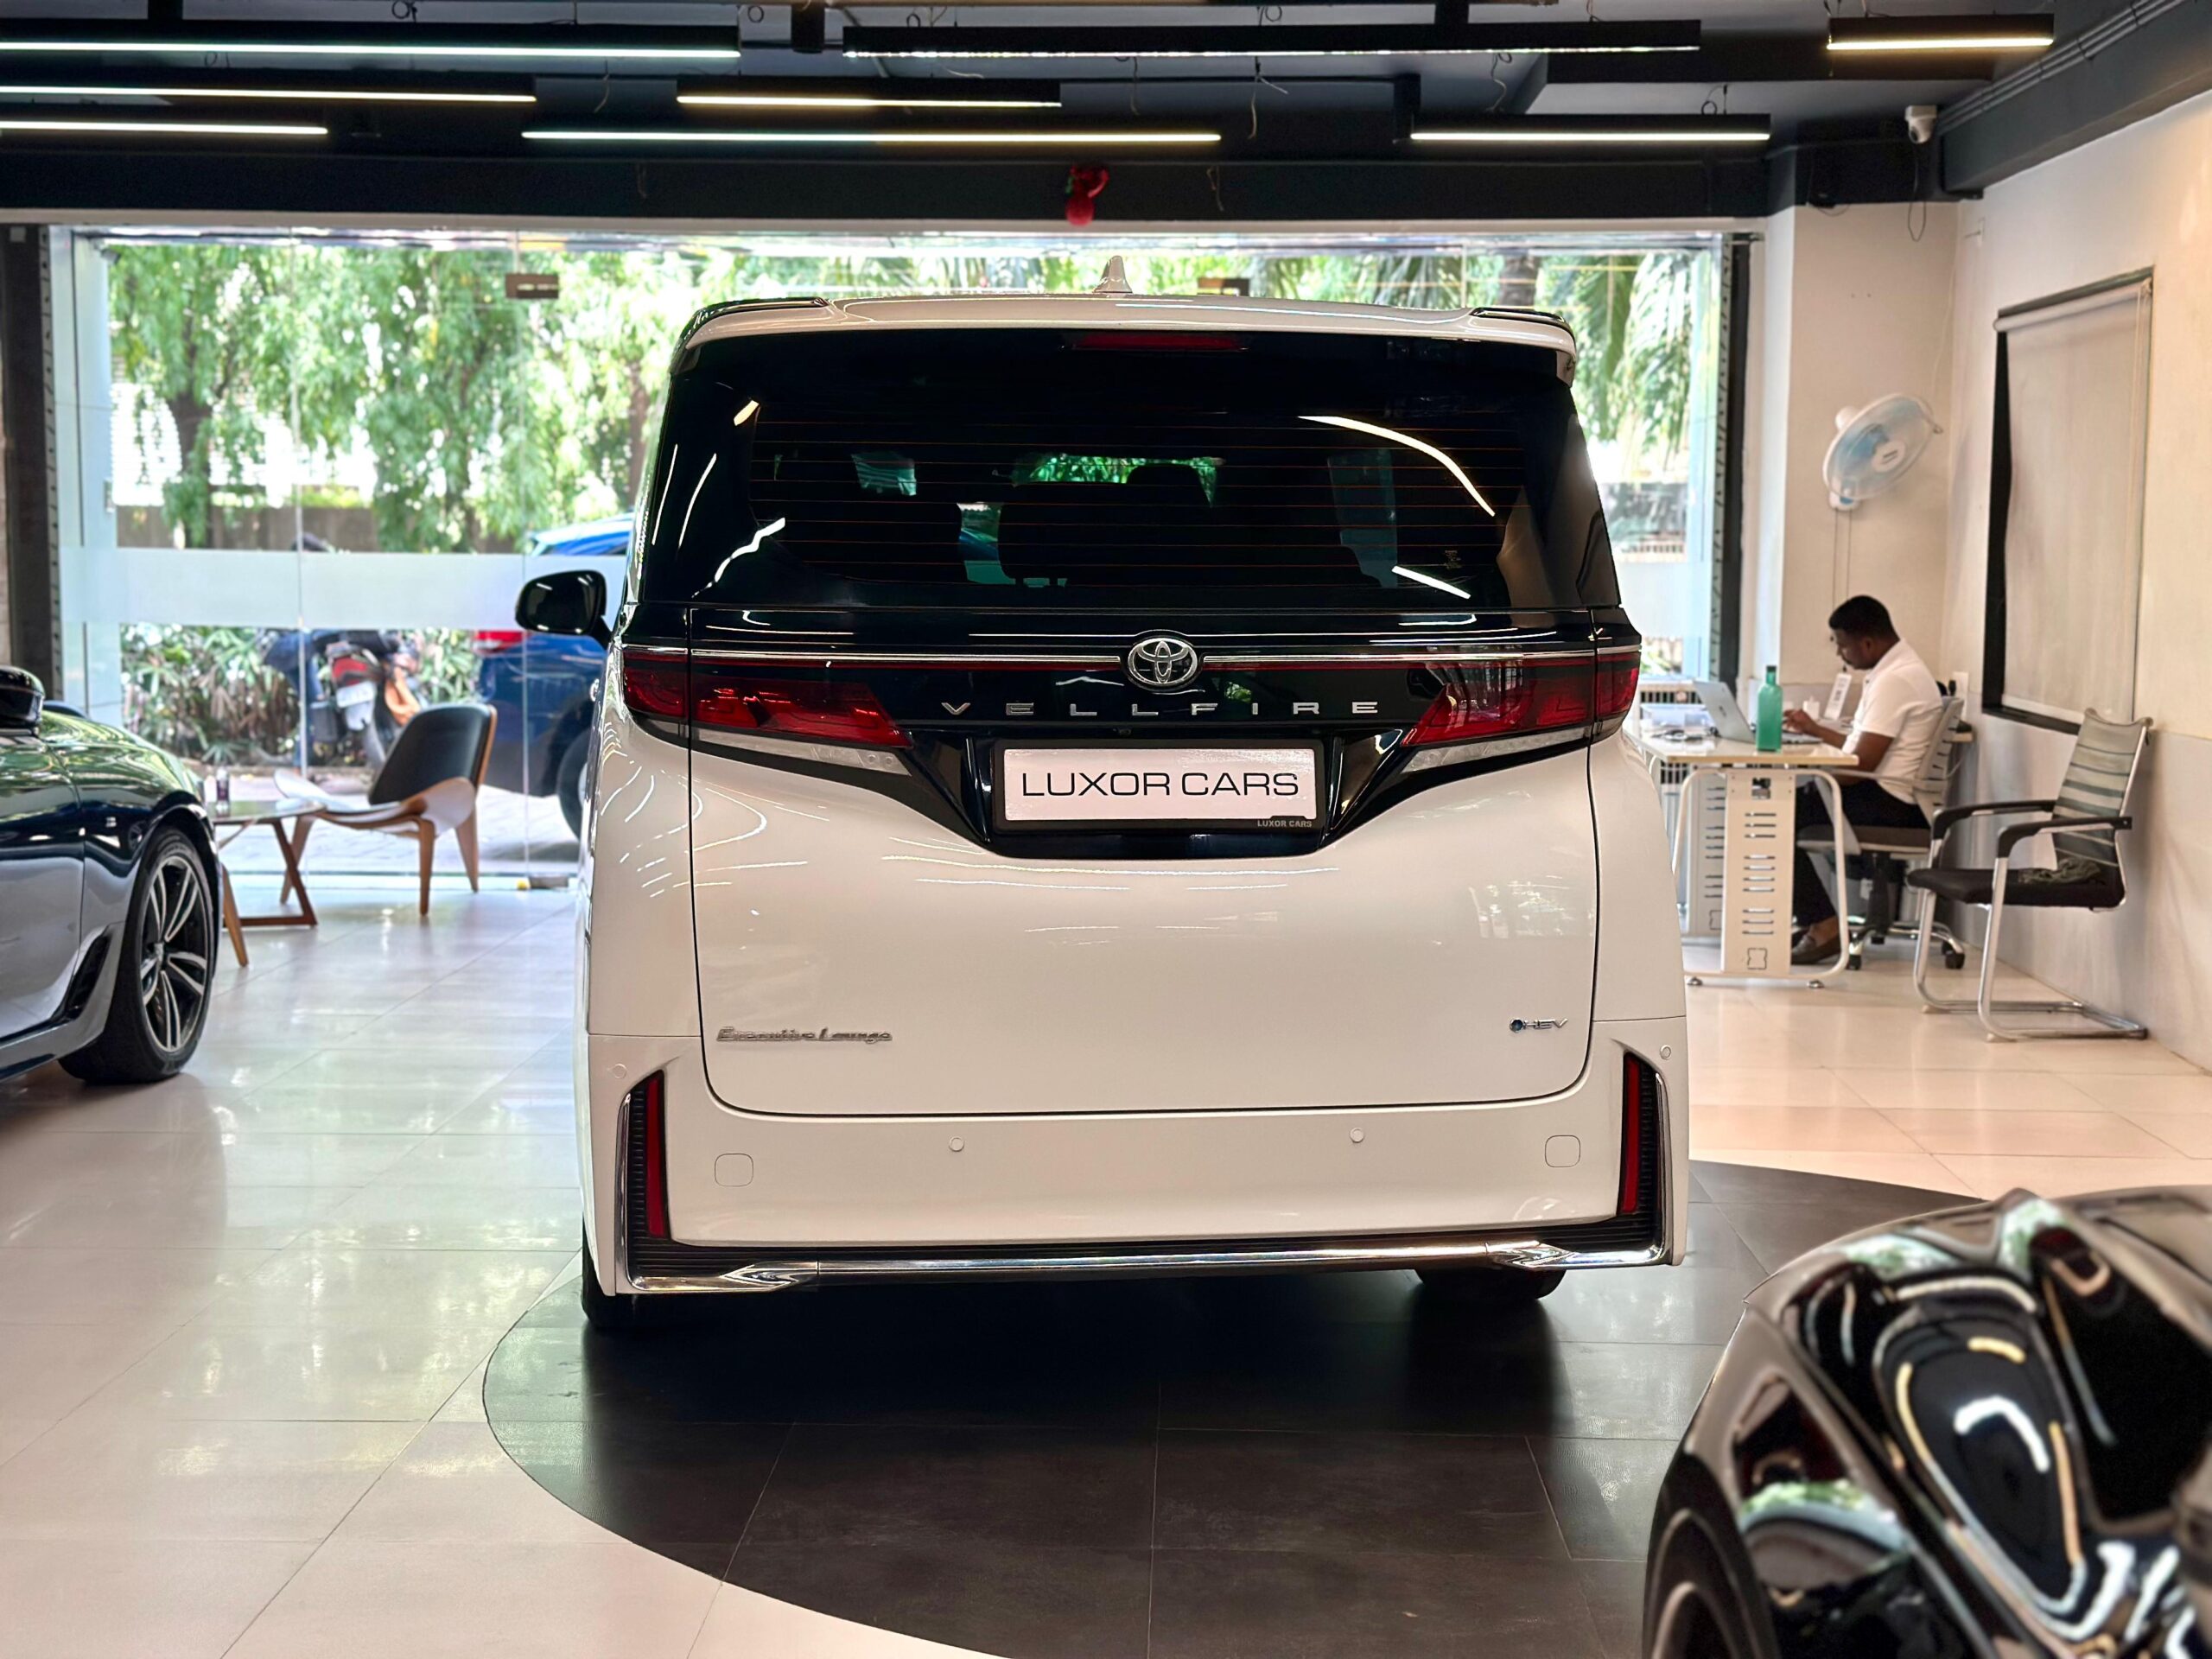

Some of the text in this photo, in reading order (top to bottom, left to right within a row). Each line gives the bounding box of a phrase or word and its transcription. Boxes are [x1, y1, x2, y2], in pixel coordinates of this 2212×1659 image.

[941, 701, 1379, 716] VELLFIRE
[1022, 772, 1300, 797] LUXOR CARS
[818, 1027, 893, 1045] Lounge
